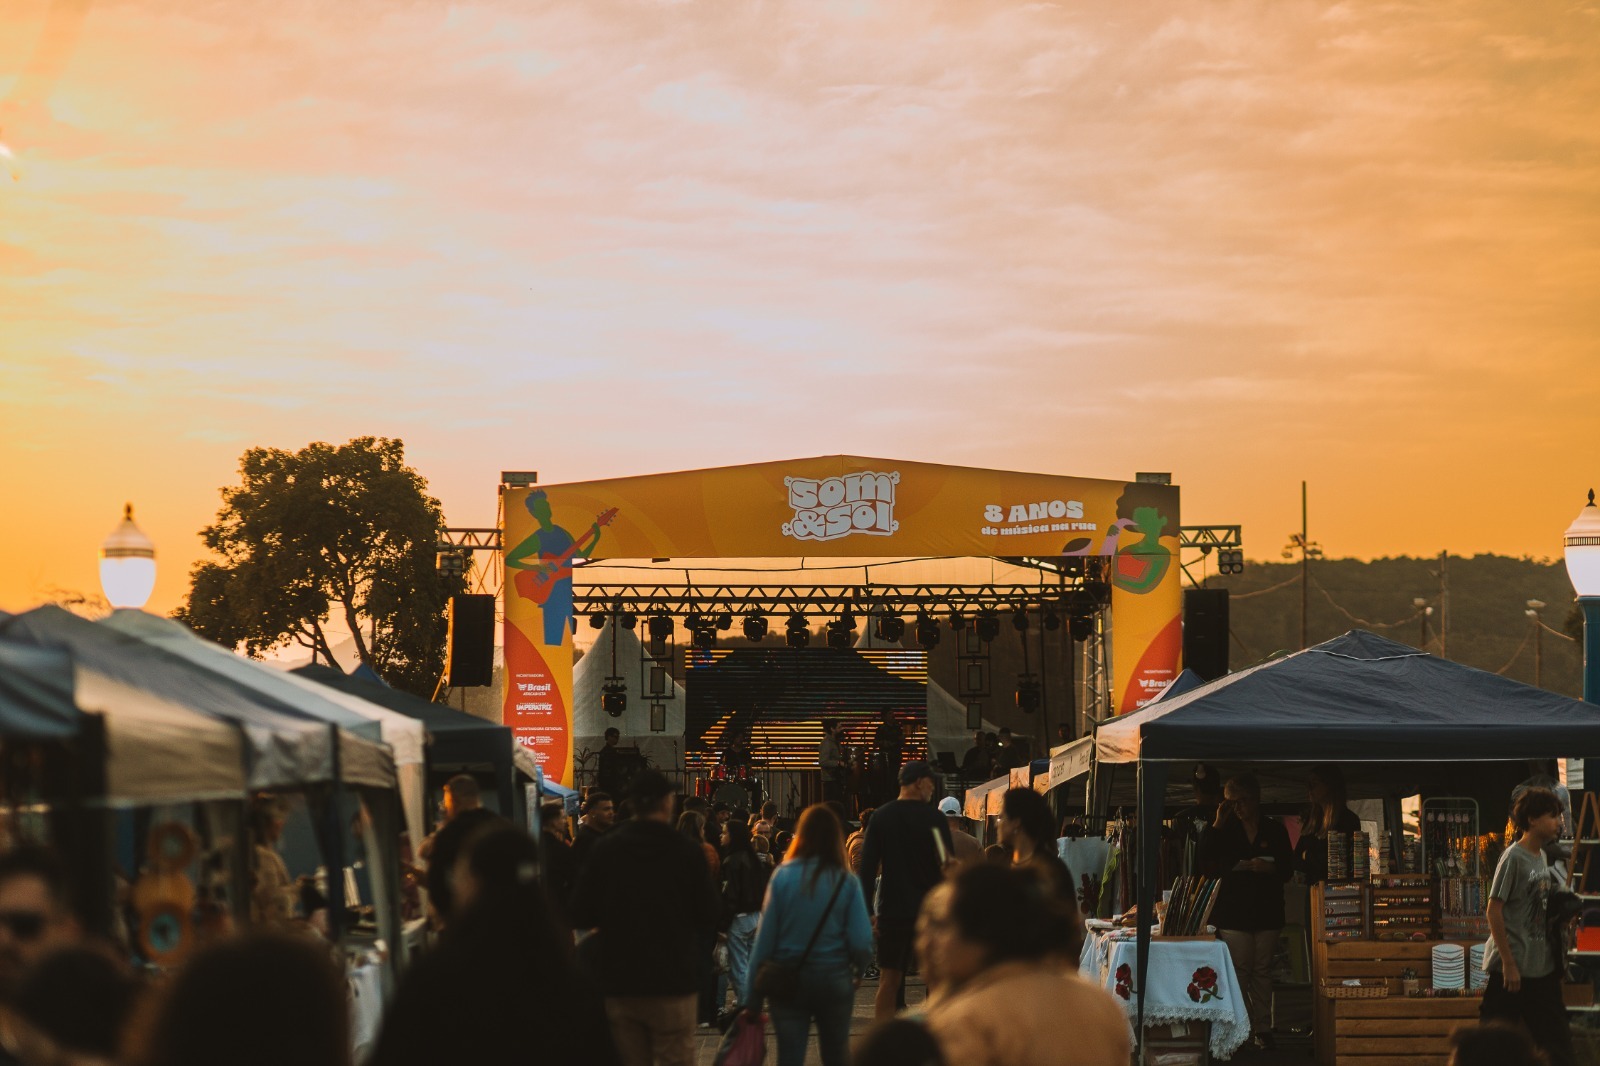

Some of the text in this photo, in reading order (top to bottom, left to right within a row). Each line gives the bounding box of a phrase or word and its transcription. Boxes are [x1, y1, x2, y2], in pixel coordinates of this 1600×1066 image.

[983, 500, 1084, 523] 8 ANOS
[981, 522, 1097, 536] de música na rua
[527, 683, 551, 691] Brasil
[516, 736, 536, 746] PIC
